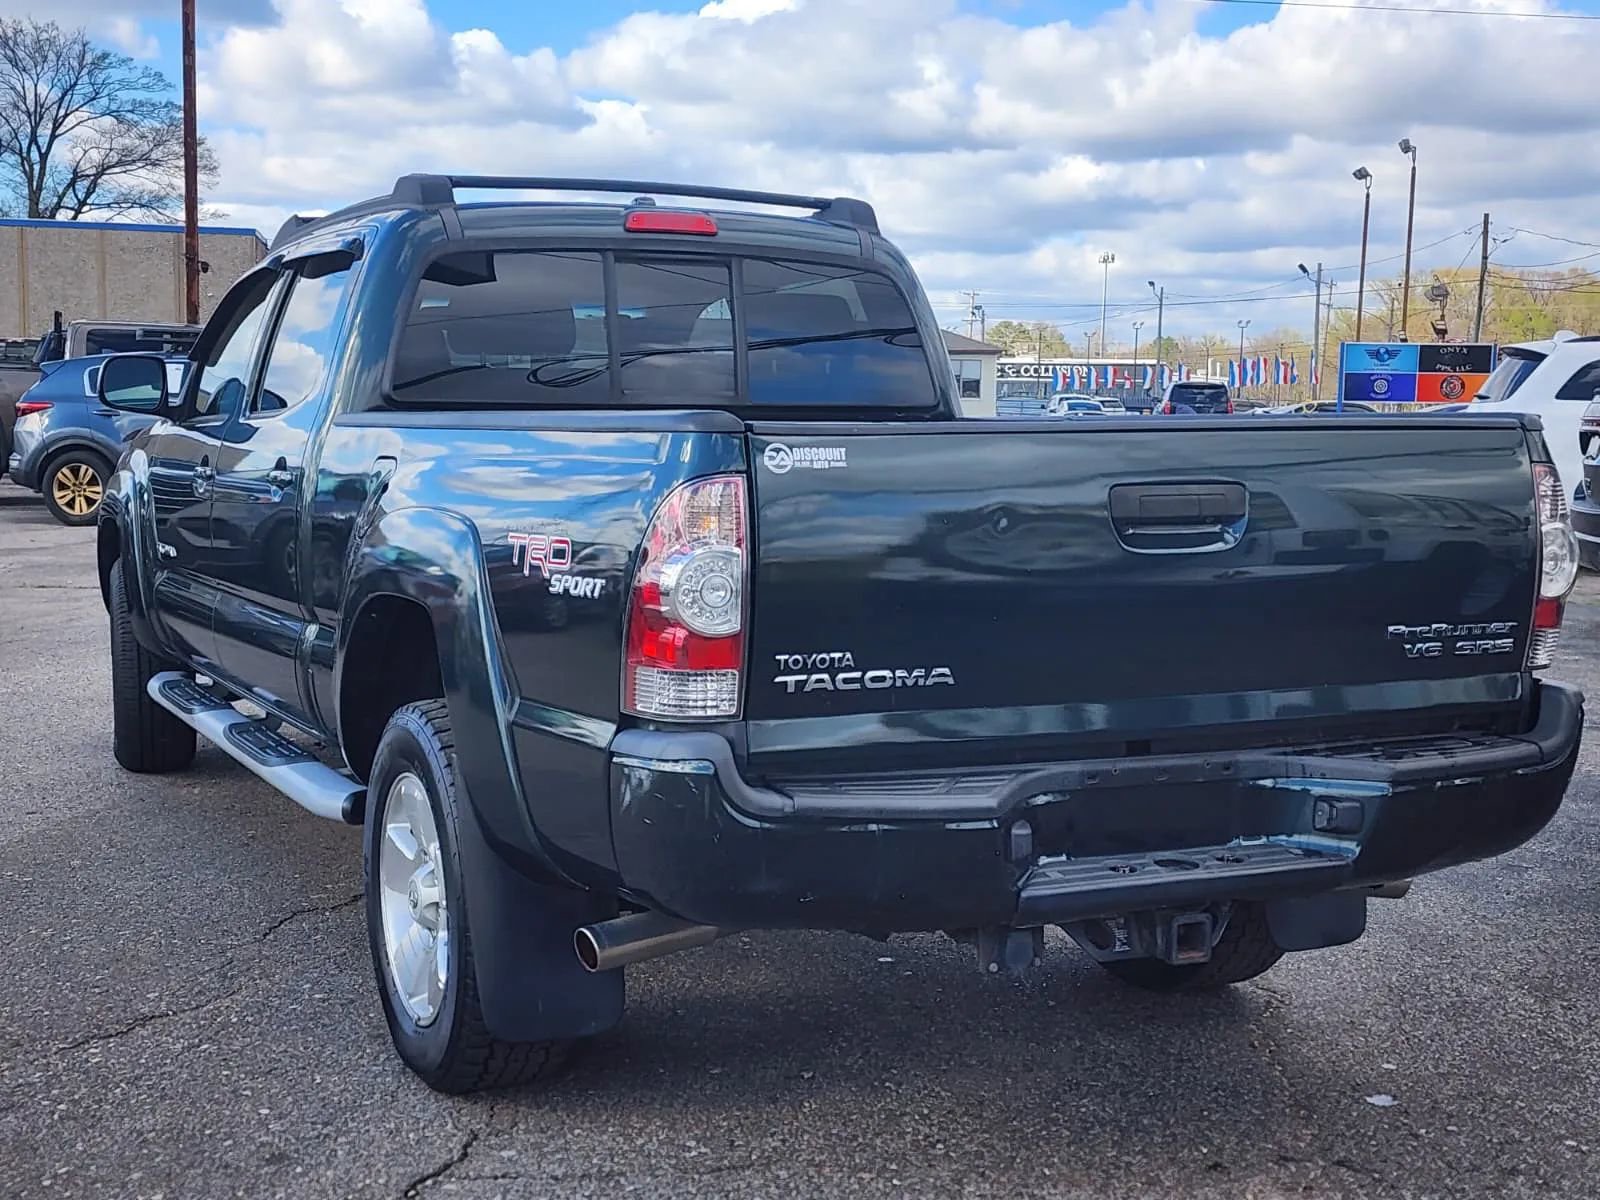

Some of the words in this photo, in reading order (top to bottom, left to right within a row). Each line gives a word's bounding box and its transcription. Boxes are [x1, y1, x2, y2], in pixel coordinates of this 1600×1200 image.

[792, 447, 846, 461] DISCOUNT
[507, 532, 572, 579] TRD
[548, 573, 606, 599] SPORT
[775, 651, 855, 670] TOYOTA
[773, 667, 955, 693] TACOMA
